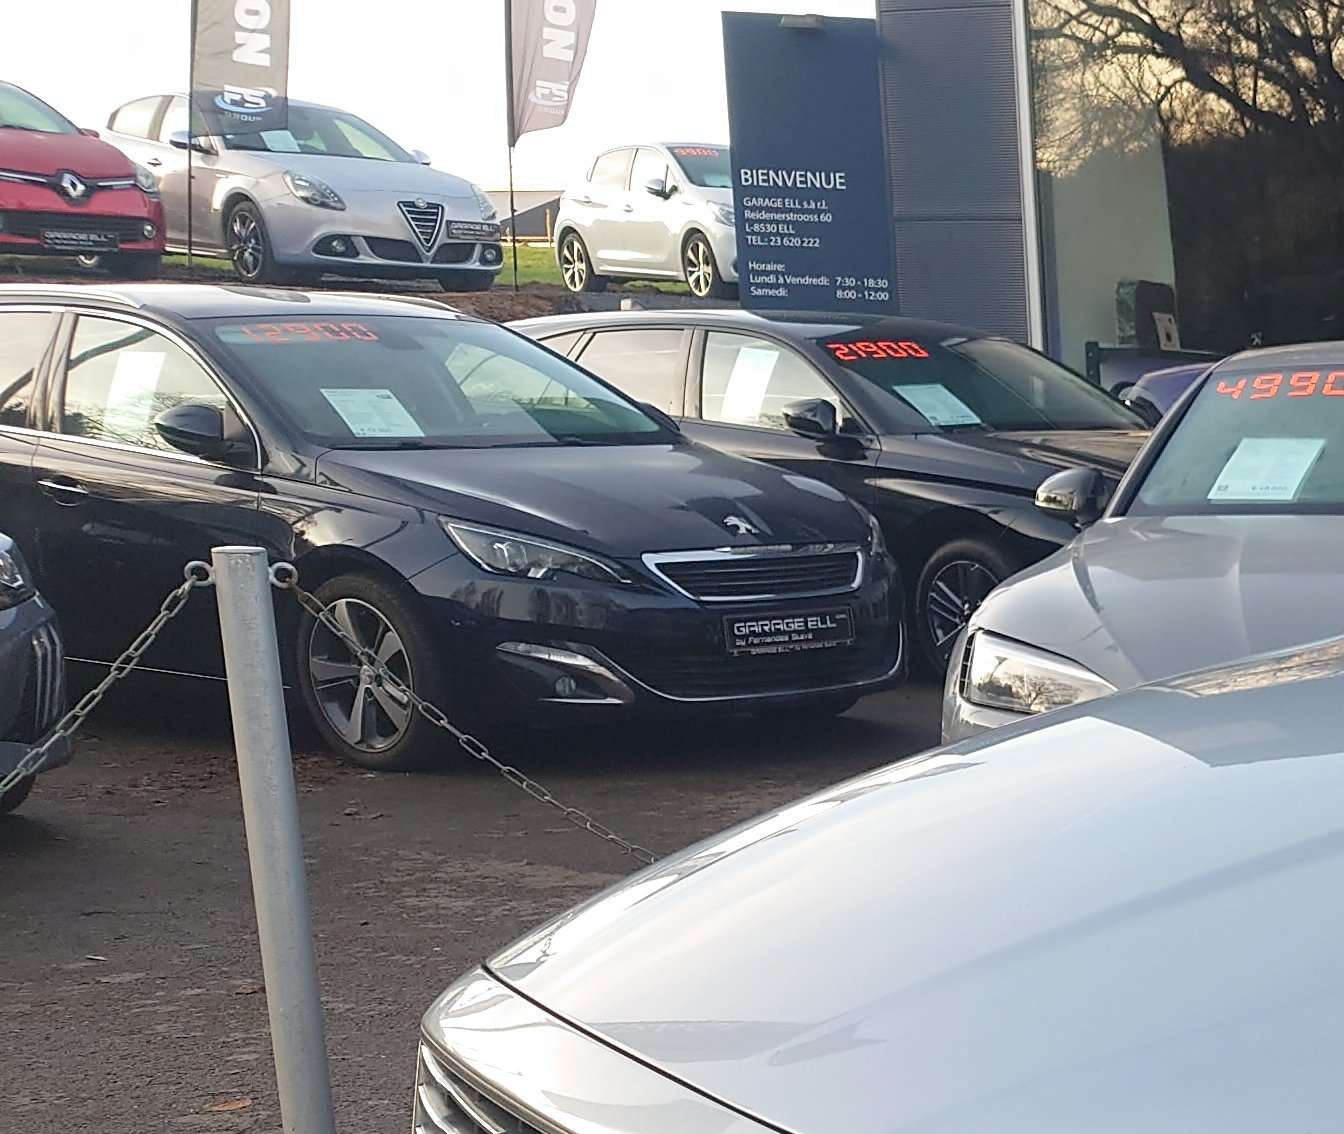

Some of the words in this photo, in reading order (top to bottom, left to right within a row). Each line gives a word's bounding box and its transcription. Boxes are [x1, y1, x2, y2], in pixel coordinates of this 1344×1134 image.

[740, 169, 847, 190] BIENVENUE
[743, 197, 783, 208] GARAGE
[785, 199, 801, 209] ELL
[820, 213, 832, 223] 60
[746, 223, 777, 233] L-8530
[778, 224, 796, 234] ELL
[770, 237, 781, 246] 23
[783, 237, 801, 247] 620
[803, 238, 820, 248] 222
[748, 261, 786, 272] Horaire:
[750, 274, 776, 284] Lundi
[777, 275, 785, 284] à
[785, 275, 830, 286] Vendredi:
[835, 277, 856, 287] 7:30
[863, 278, 889, 288] 18:30
[751, 286, 789, 297] Samedi:
[836, 289, 857, 300] 8:00
[864, 290, 889, 301] 12:00
[826, 341, 929, 361] 21900
[733, 618, 806, 636] GARAGE
[807, 615, 837, 629] ELL
